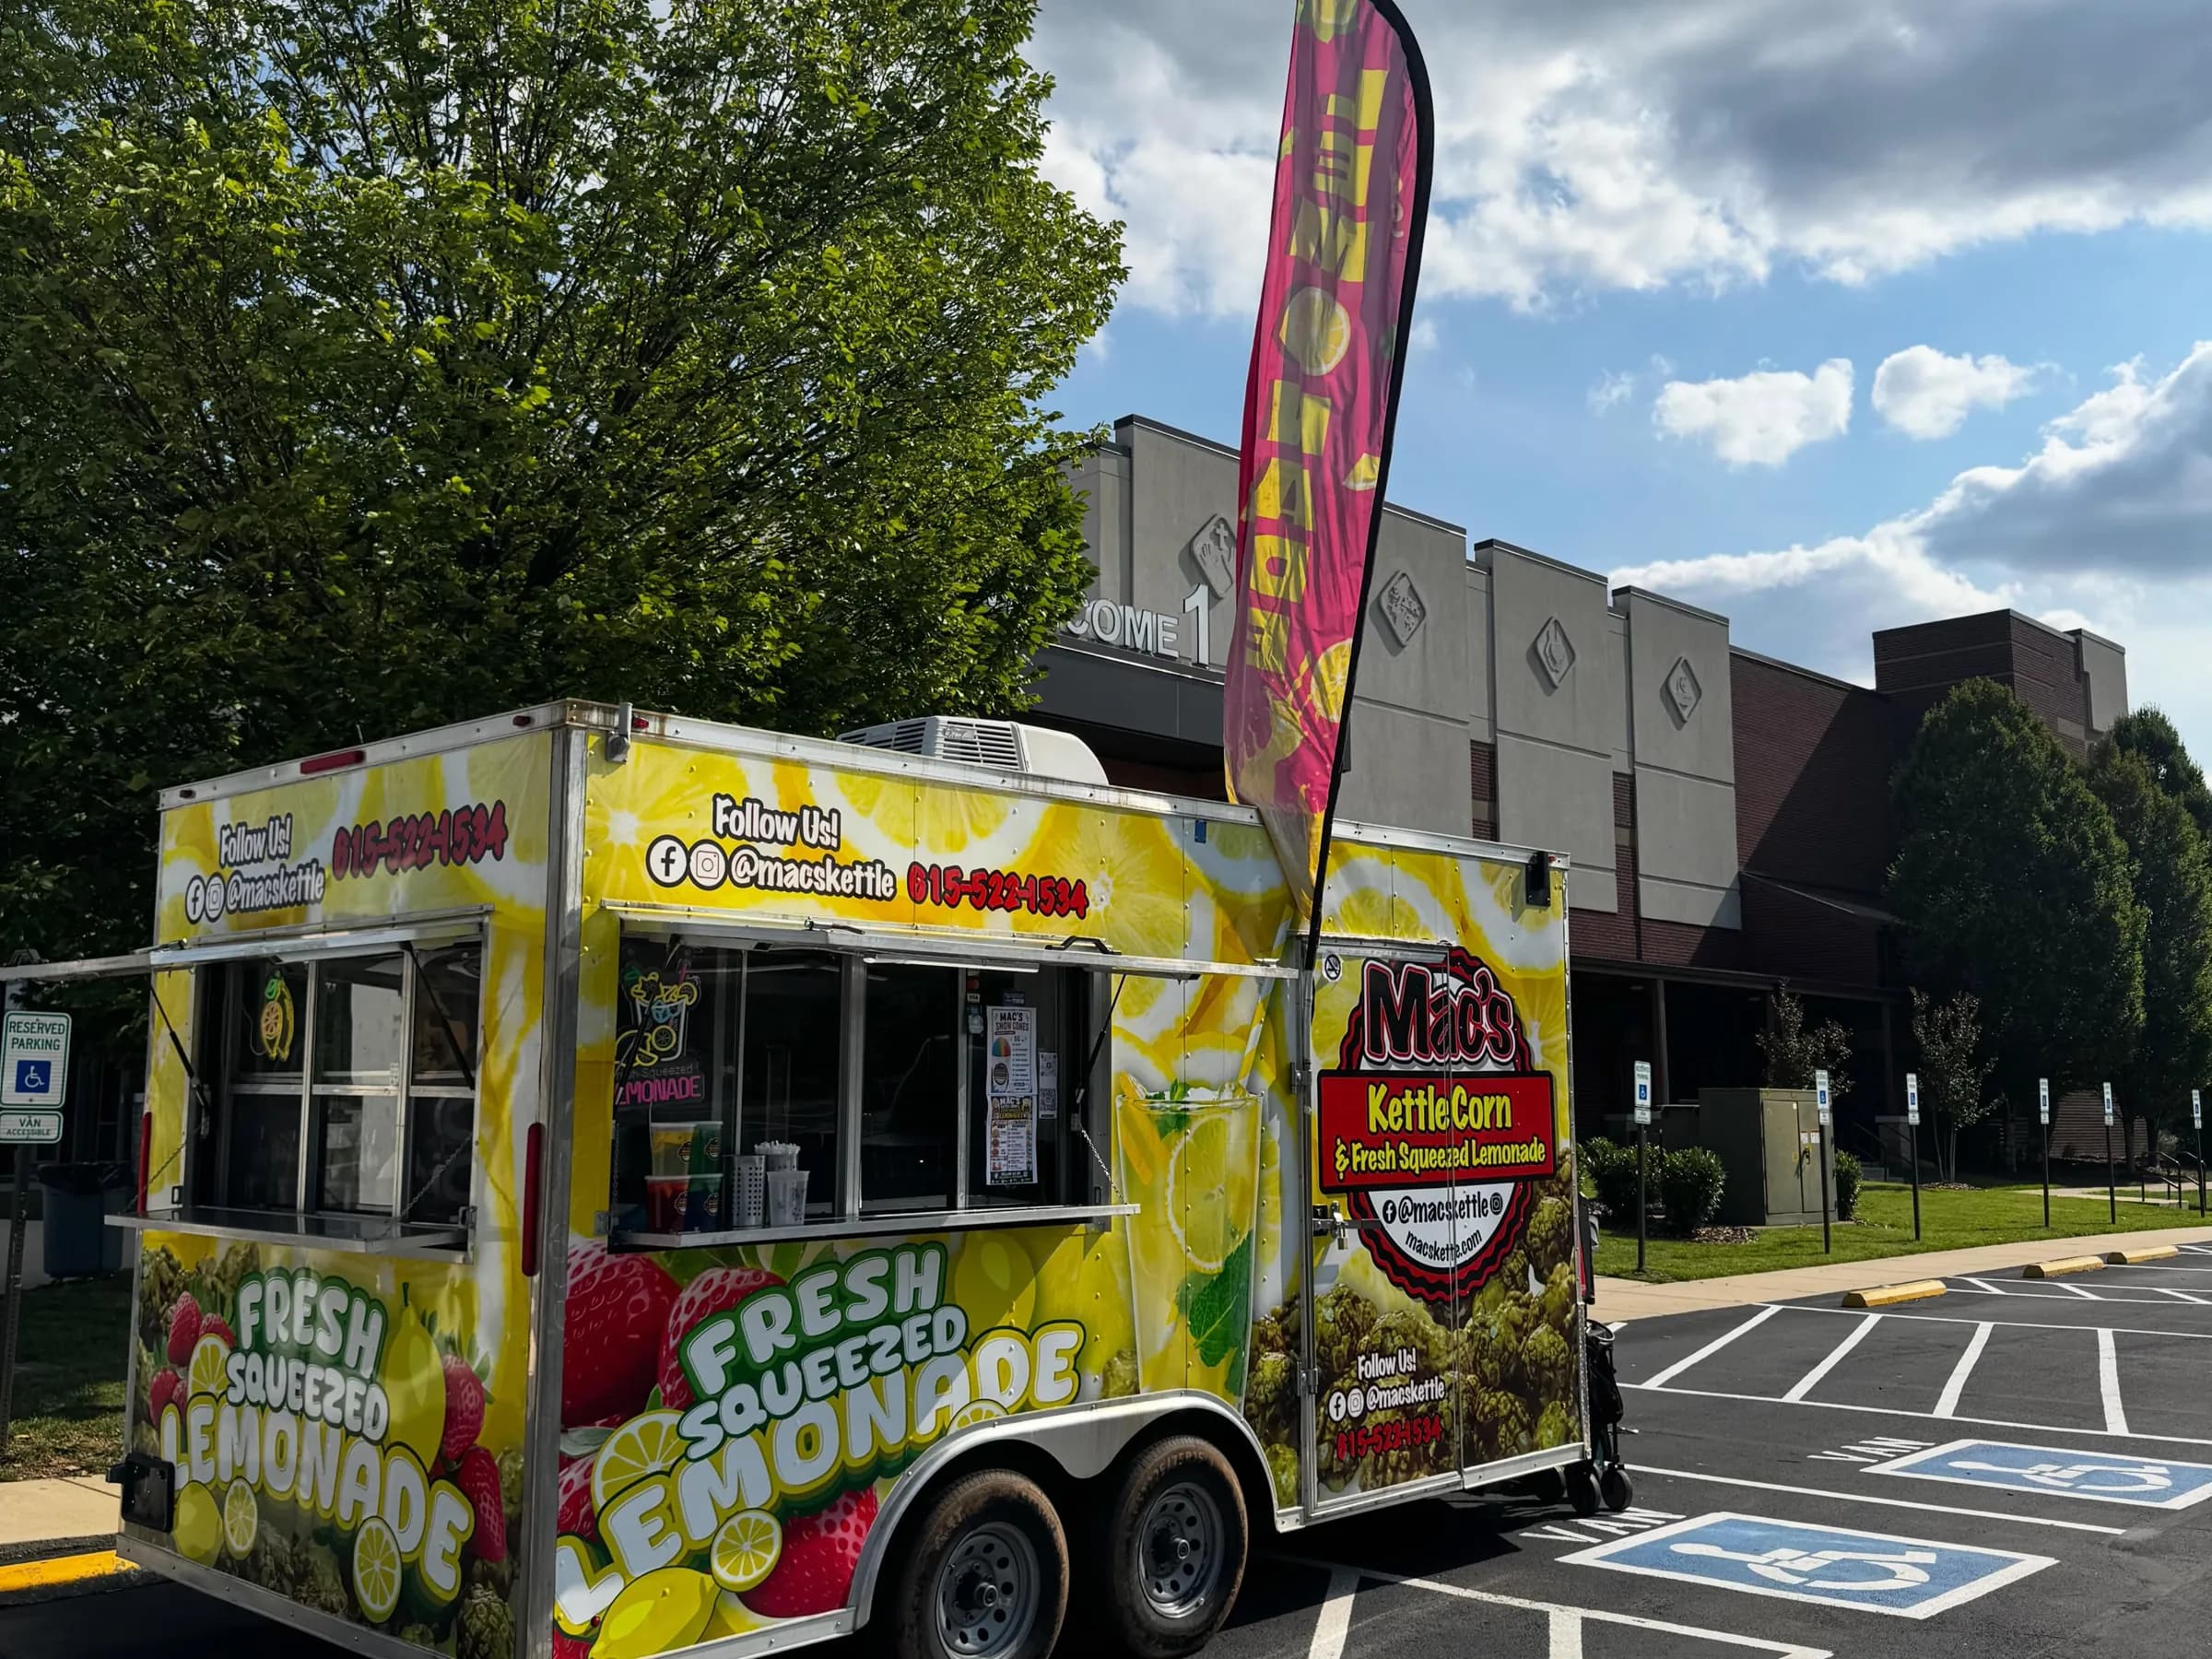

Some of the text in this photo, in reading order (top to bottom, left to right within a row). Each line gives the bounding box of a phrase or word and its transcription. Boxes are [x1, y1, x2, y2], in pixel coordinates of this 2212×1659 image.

[1182, 583, 1210, 665] 1
[220, 814, 292, 868] Follow Us!
[333, 800, 508, 880] 615-522-1534
[713, 794, 840, 851] Follow Us!
[226, 859, 324, 912] @macskettle
[731, 847, 896, 900] @macskettle
[908, 862, 1088, 918] 615-522-1534
[8, 1021, 65, 1035] RESERVED
[1000, 1012, 1023, 1021] MAC'S
[1364, 959, 1515, 1063] Mac's
[11, 1038, 61, 1051] PARKING
[6, 1128, 51, 1136] ACCESSIBLE
[19, 1118, 41, 1128] VAN
[1367, 1082, 1512, 1133] Kettle Corn
[1335, 1136, 1546, 1182] & Fresh Squeezed Lemonade
[1398, 1191, 1489, 1224] @macskettle
[1405, 1229, 1483, 1262] macskette.com
[239, 1275, 385, 1379] FRESH
[684, 1248, 943, 1396] FRESH
[678, 1305, 967, 1461] SQUEEZED
[1358, 1347, 1417, 1381] Follow Us!
[227, 1352, 389, 1442] SQUEEZED
[1366, 1376, 1445, 1410] @macskettle
[1336, 1414, 1442, 1461] 615-522-1534
[162, 1403, 472, 1594] LEMONADE
[555, 1324, 1081, 1628] LEMONADE
